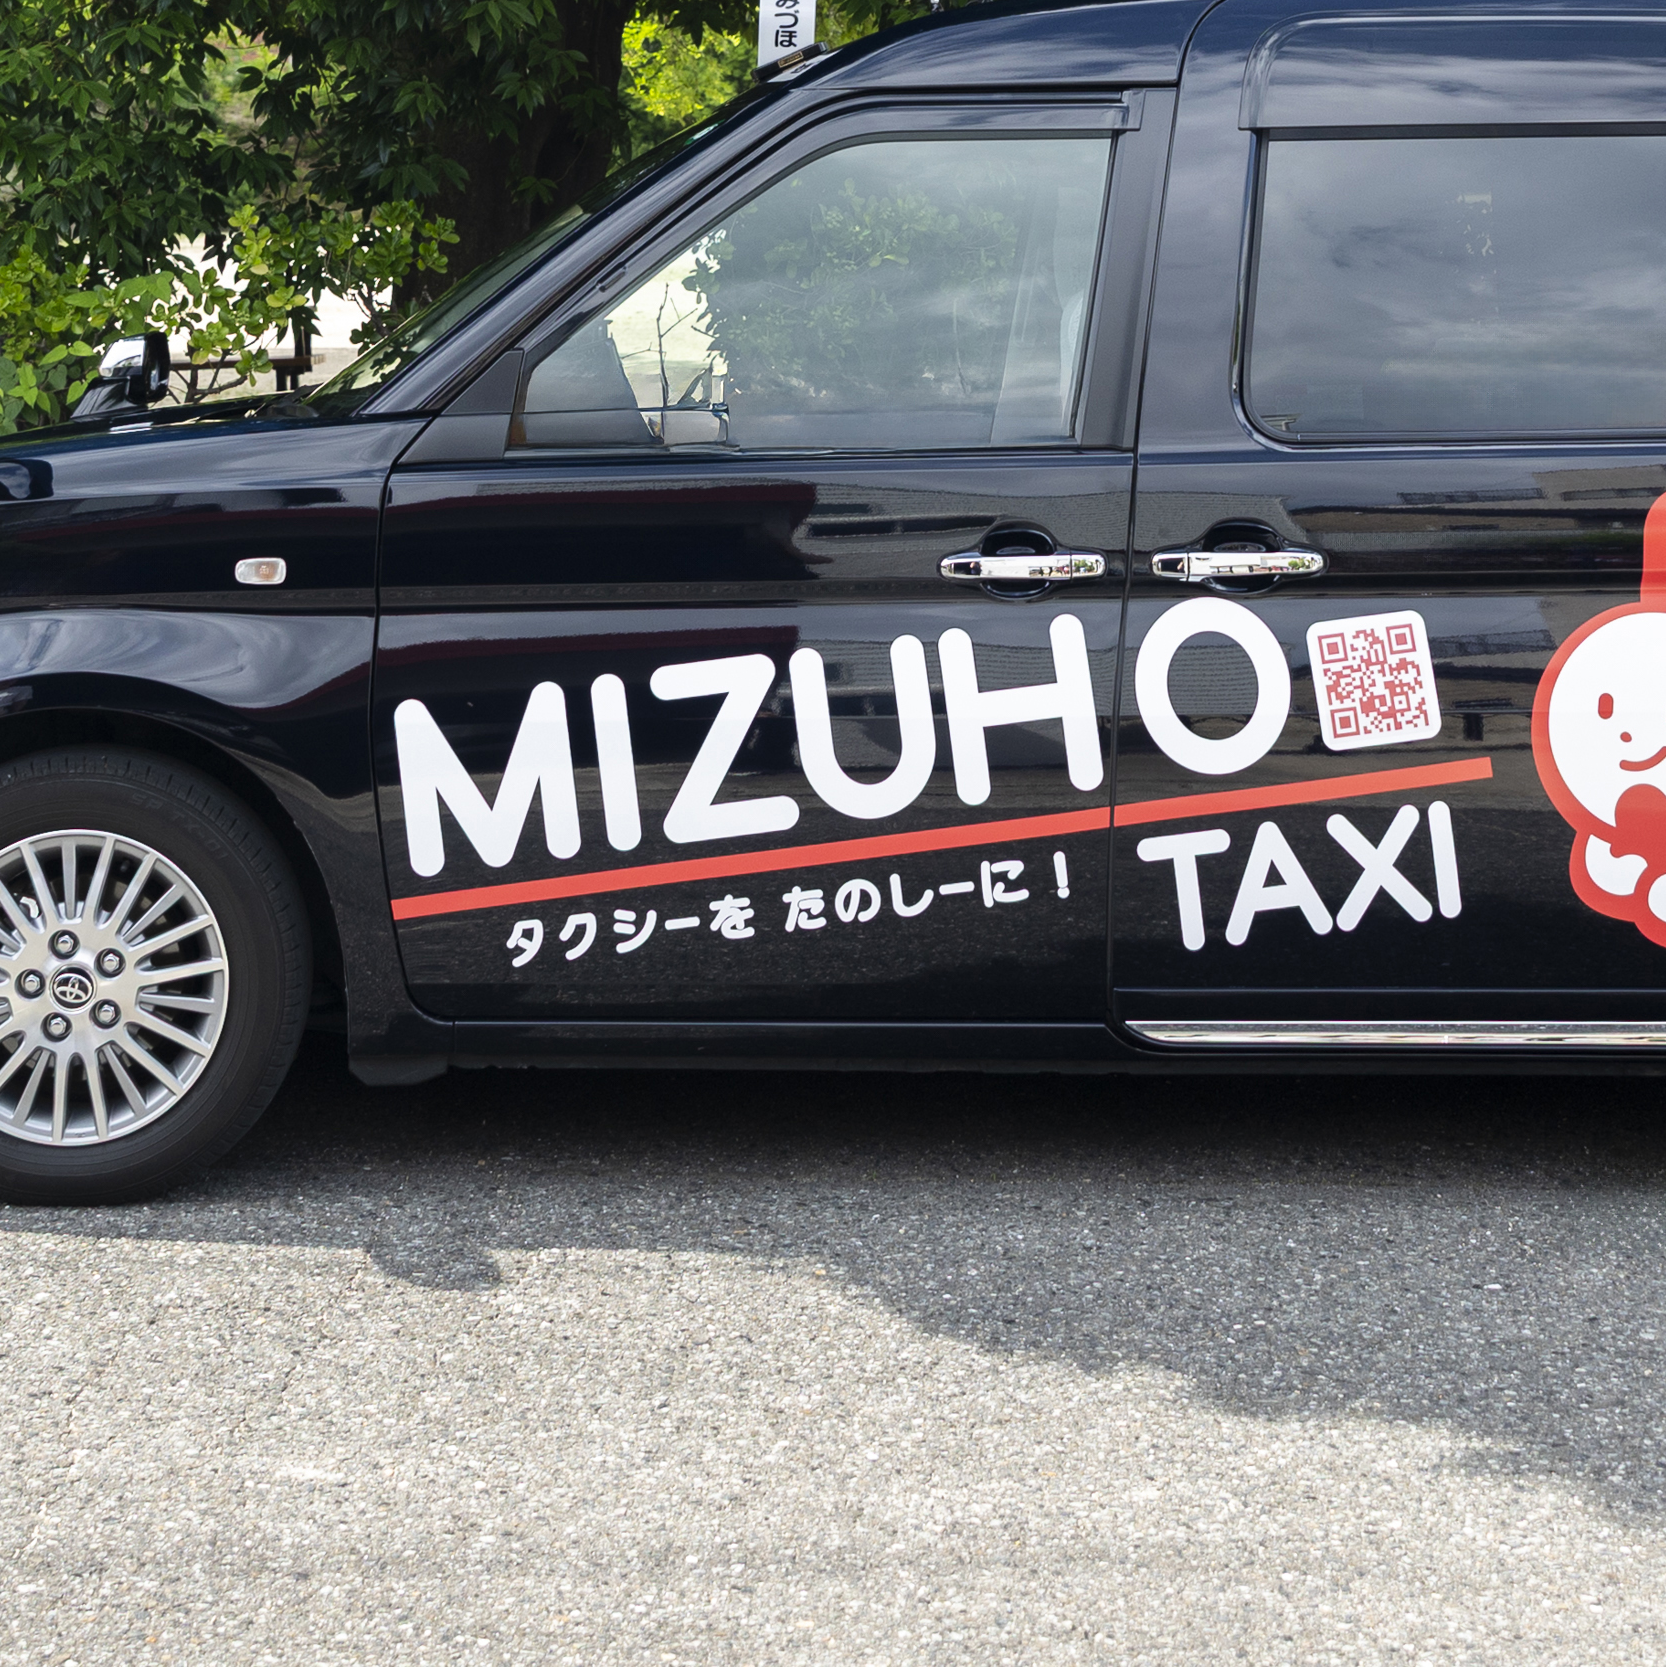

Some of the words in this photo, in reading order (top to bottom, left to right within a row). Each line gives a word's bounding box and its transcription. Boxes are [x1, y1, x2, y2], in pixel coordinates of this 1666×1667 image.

[393, 596, 1291, 877] MIZUHO
[506, 894, 755, 968] タクシーを
[1136, 800, 1463, 951] TAXI
